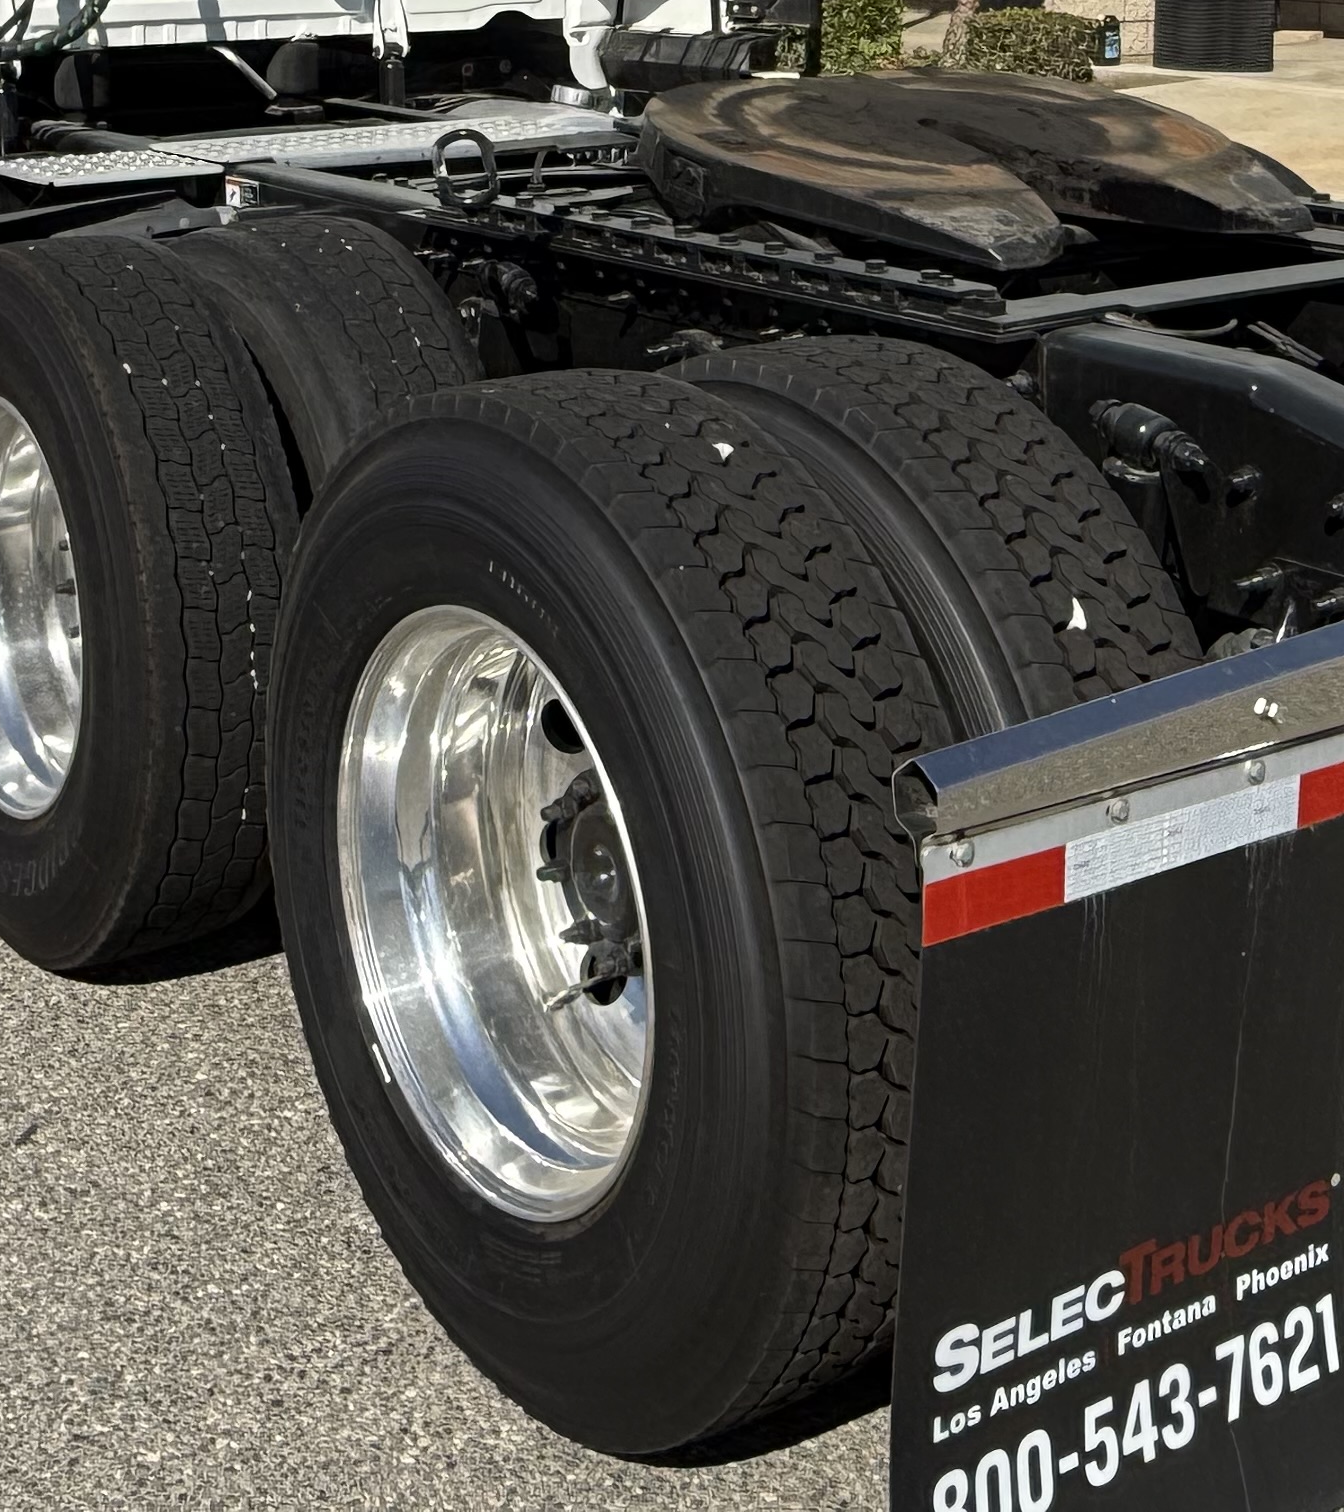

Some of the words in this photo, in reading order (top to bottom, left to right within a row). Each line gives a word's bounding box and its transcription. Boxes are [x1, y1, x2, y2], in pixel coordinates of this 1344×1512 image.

[932, 1178, 1332, 1393] SELECTRUCKS
[933, 1404, 982, 1444] Los
[989, 1349, 1097, 1417] Angeles
[1117, 1294, 1216, 1356] Fontana
[1236, 1241, 1330, 1301] Phoenix
[932, 1292, 1340, 1512] 800-543-7621
